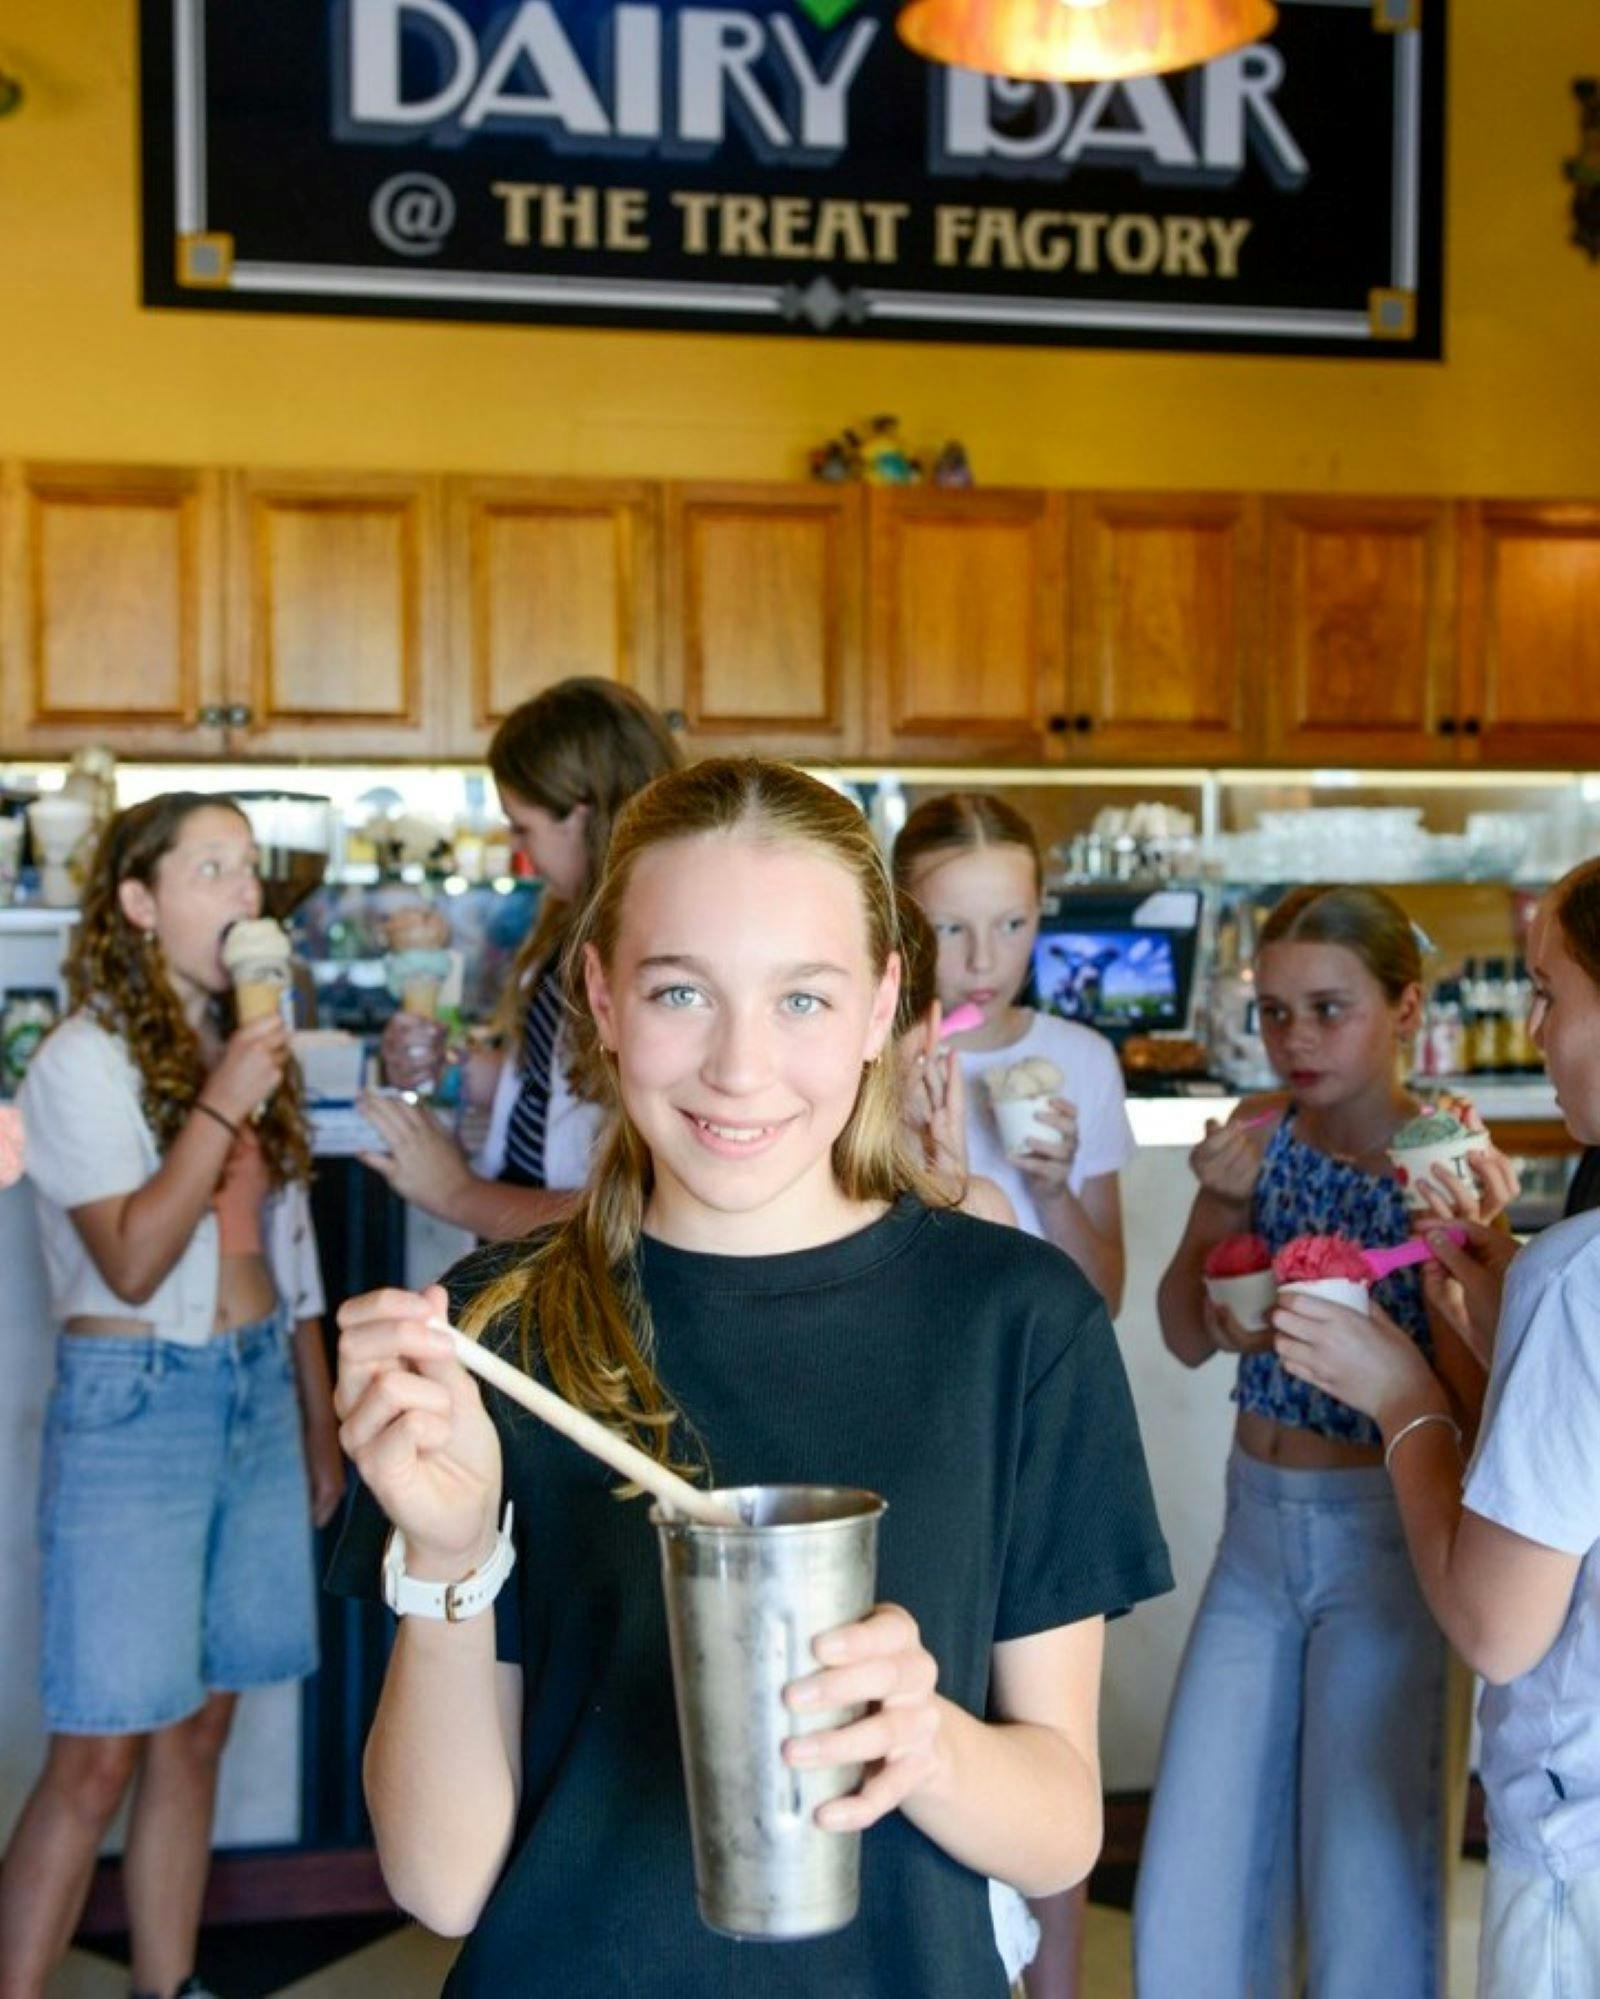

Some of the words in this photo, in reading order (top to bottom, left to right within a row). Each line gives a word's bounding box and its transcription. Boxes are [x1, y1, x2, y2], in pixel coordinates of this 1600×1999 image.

[348, 0, 879, 150] DAIRY
[942, 42, 1310, 175] BAR
[370, 171, 457, 257] @
[492, 180, 650, 251] THE
[671, 190, 909, 265] TREAT
[933, 204, 1252, 278] FACTORY
